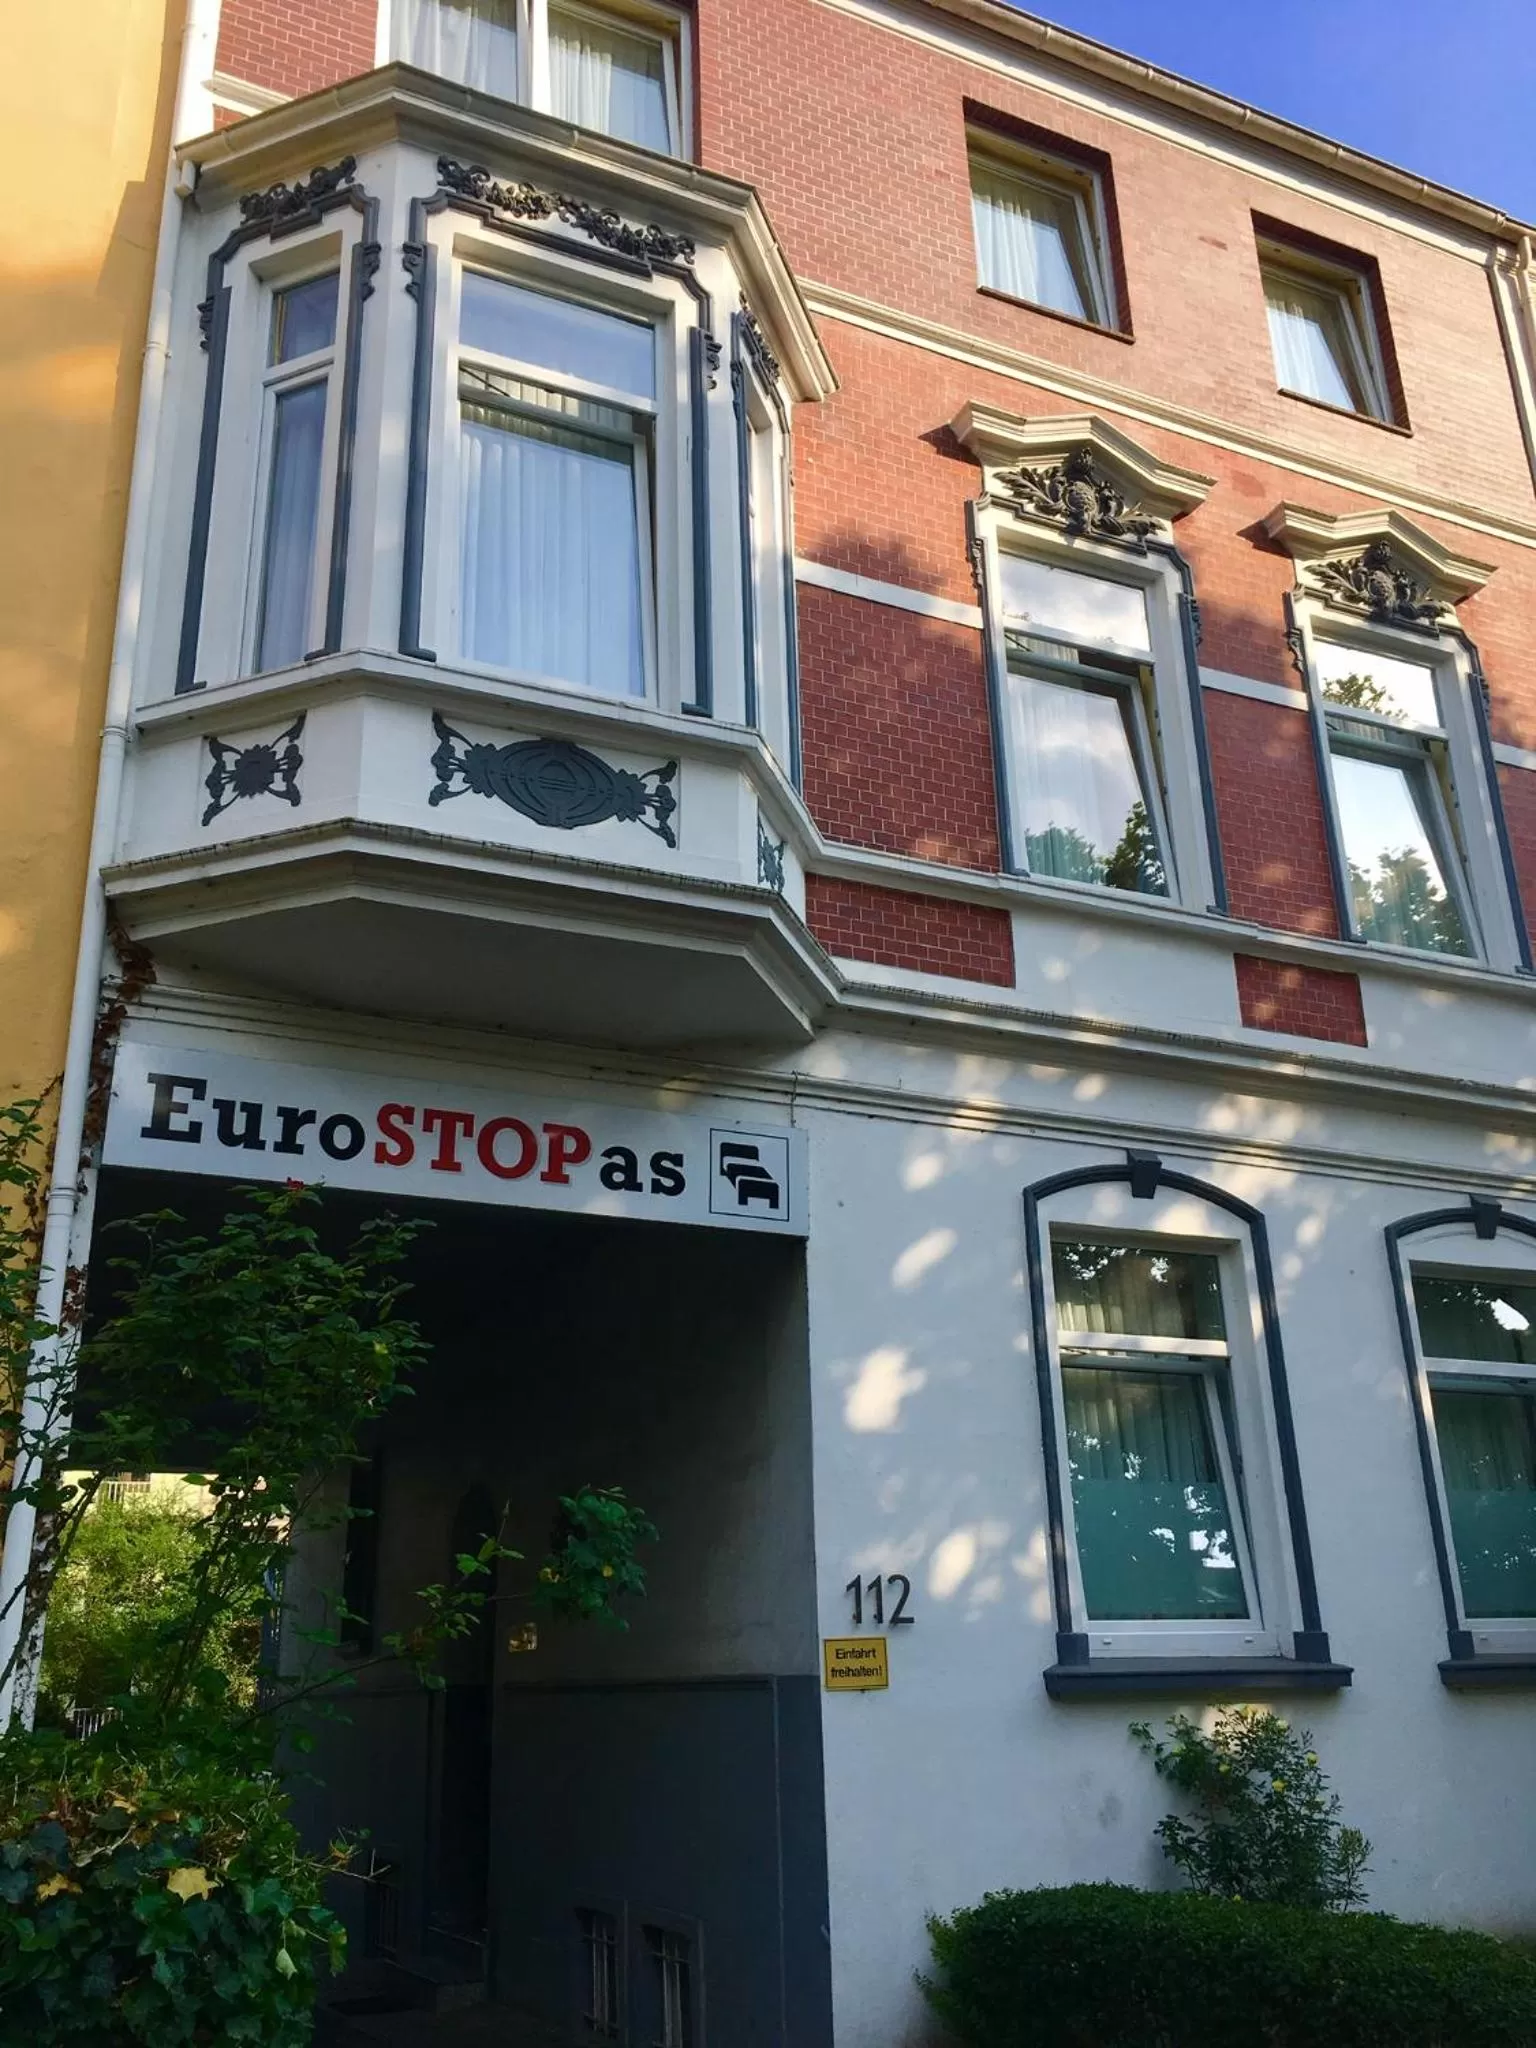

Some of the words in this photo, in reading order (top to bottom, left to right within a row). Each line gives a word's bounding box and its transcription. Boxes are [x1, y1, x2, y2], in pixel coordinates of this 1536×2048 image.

[141, 1072, 684, 1196] EuroSTOPas
[846, 1574, 915, 1624] 112
[835, 1648, 876, 1660] Einfahrt
[831, 1665, 882, 1678] freihalten!
